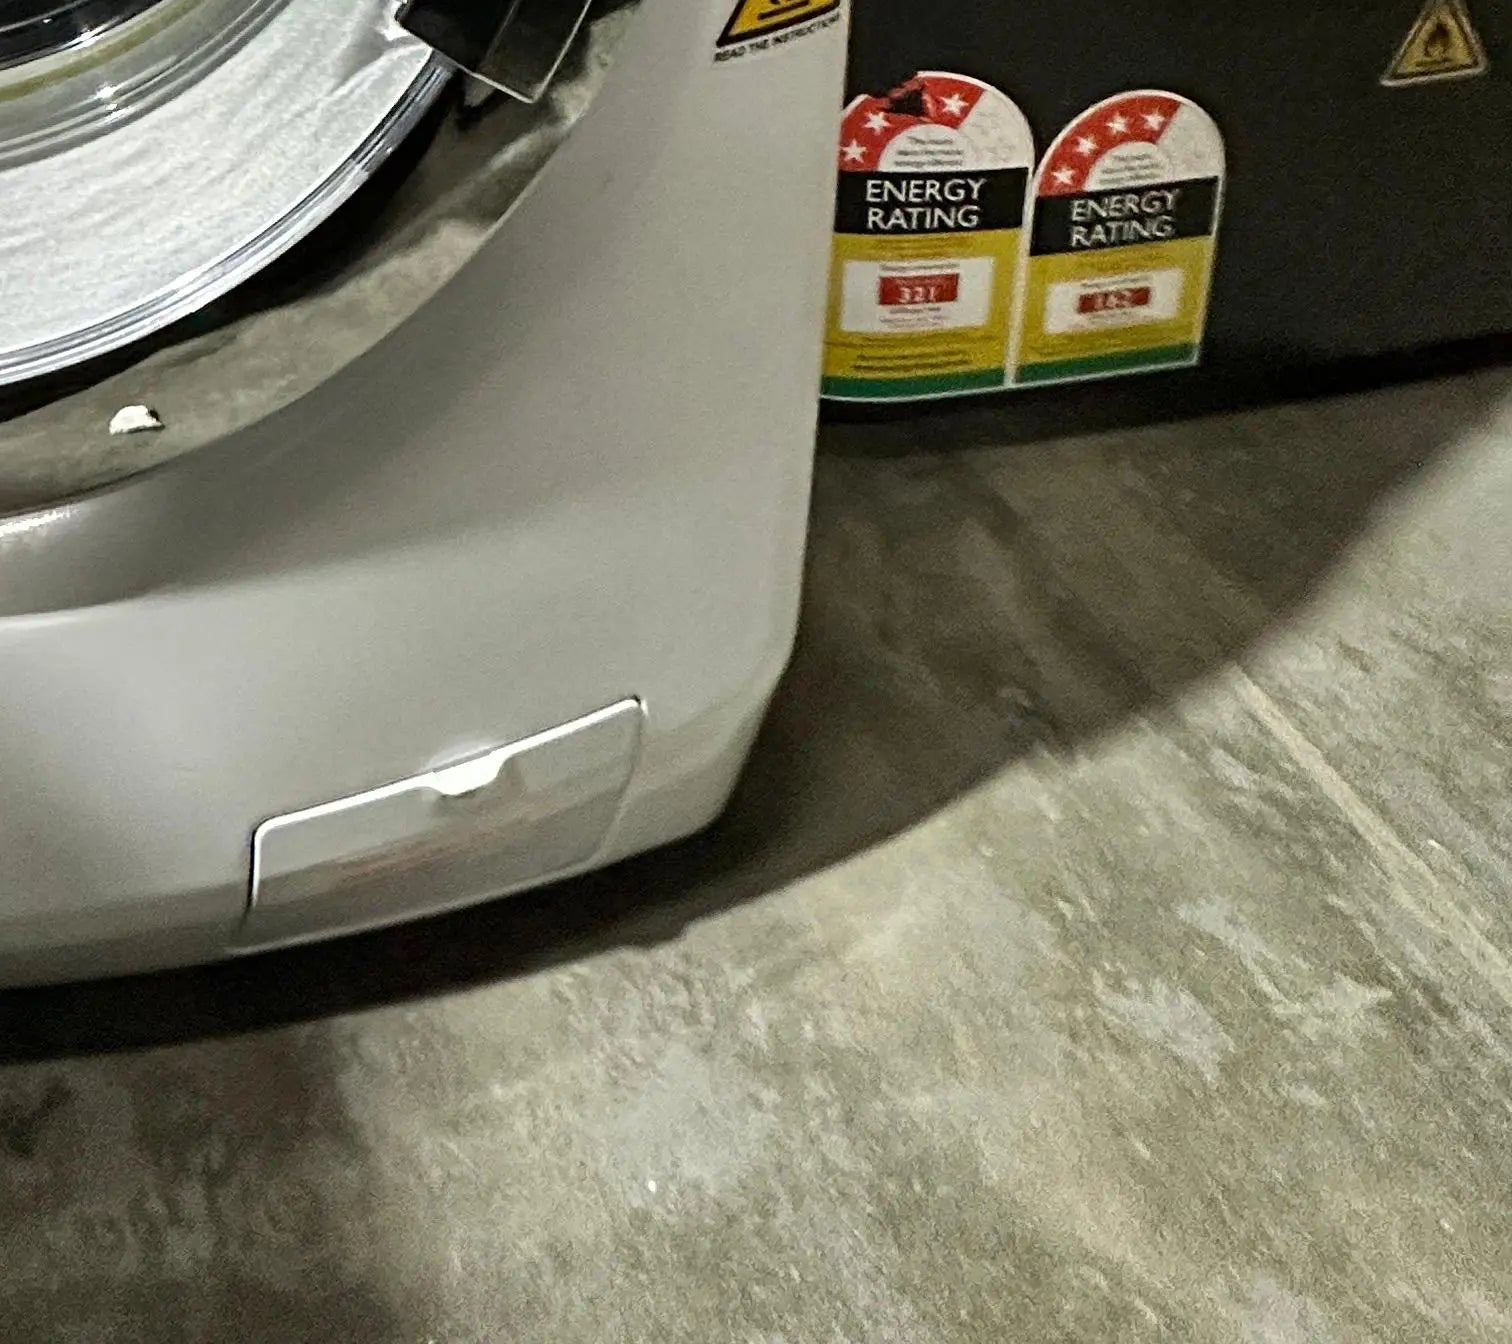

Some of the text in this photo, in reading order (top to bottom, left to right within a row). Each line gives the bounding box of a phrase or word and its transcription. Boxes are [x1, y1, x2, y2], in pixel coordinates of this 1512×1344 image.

[866, 177, 986, 205] ENERGY
[1071, 189, 1179, 223] ENERGY
[867, 204, 980, 231] RATING
[1070, 218, 1173, 251] RATING
